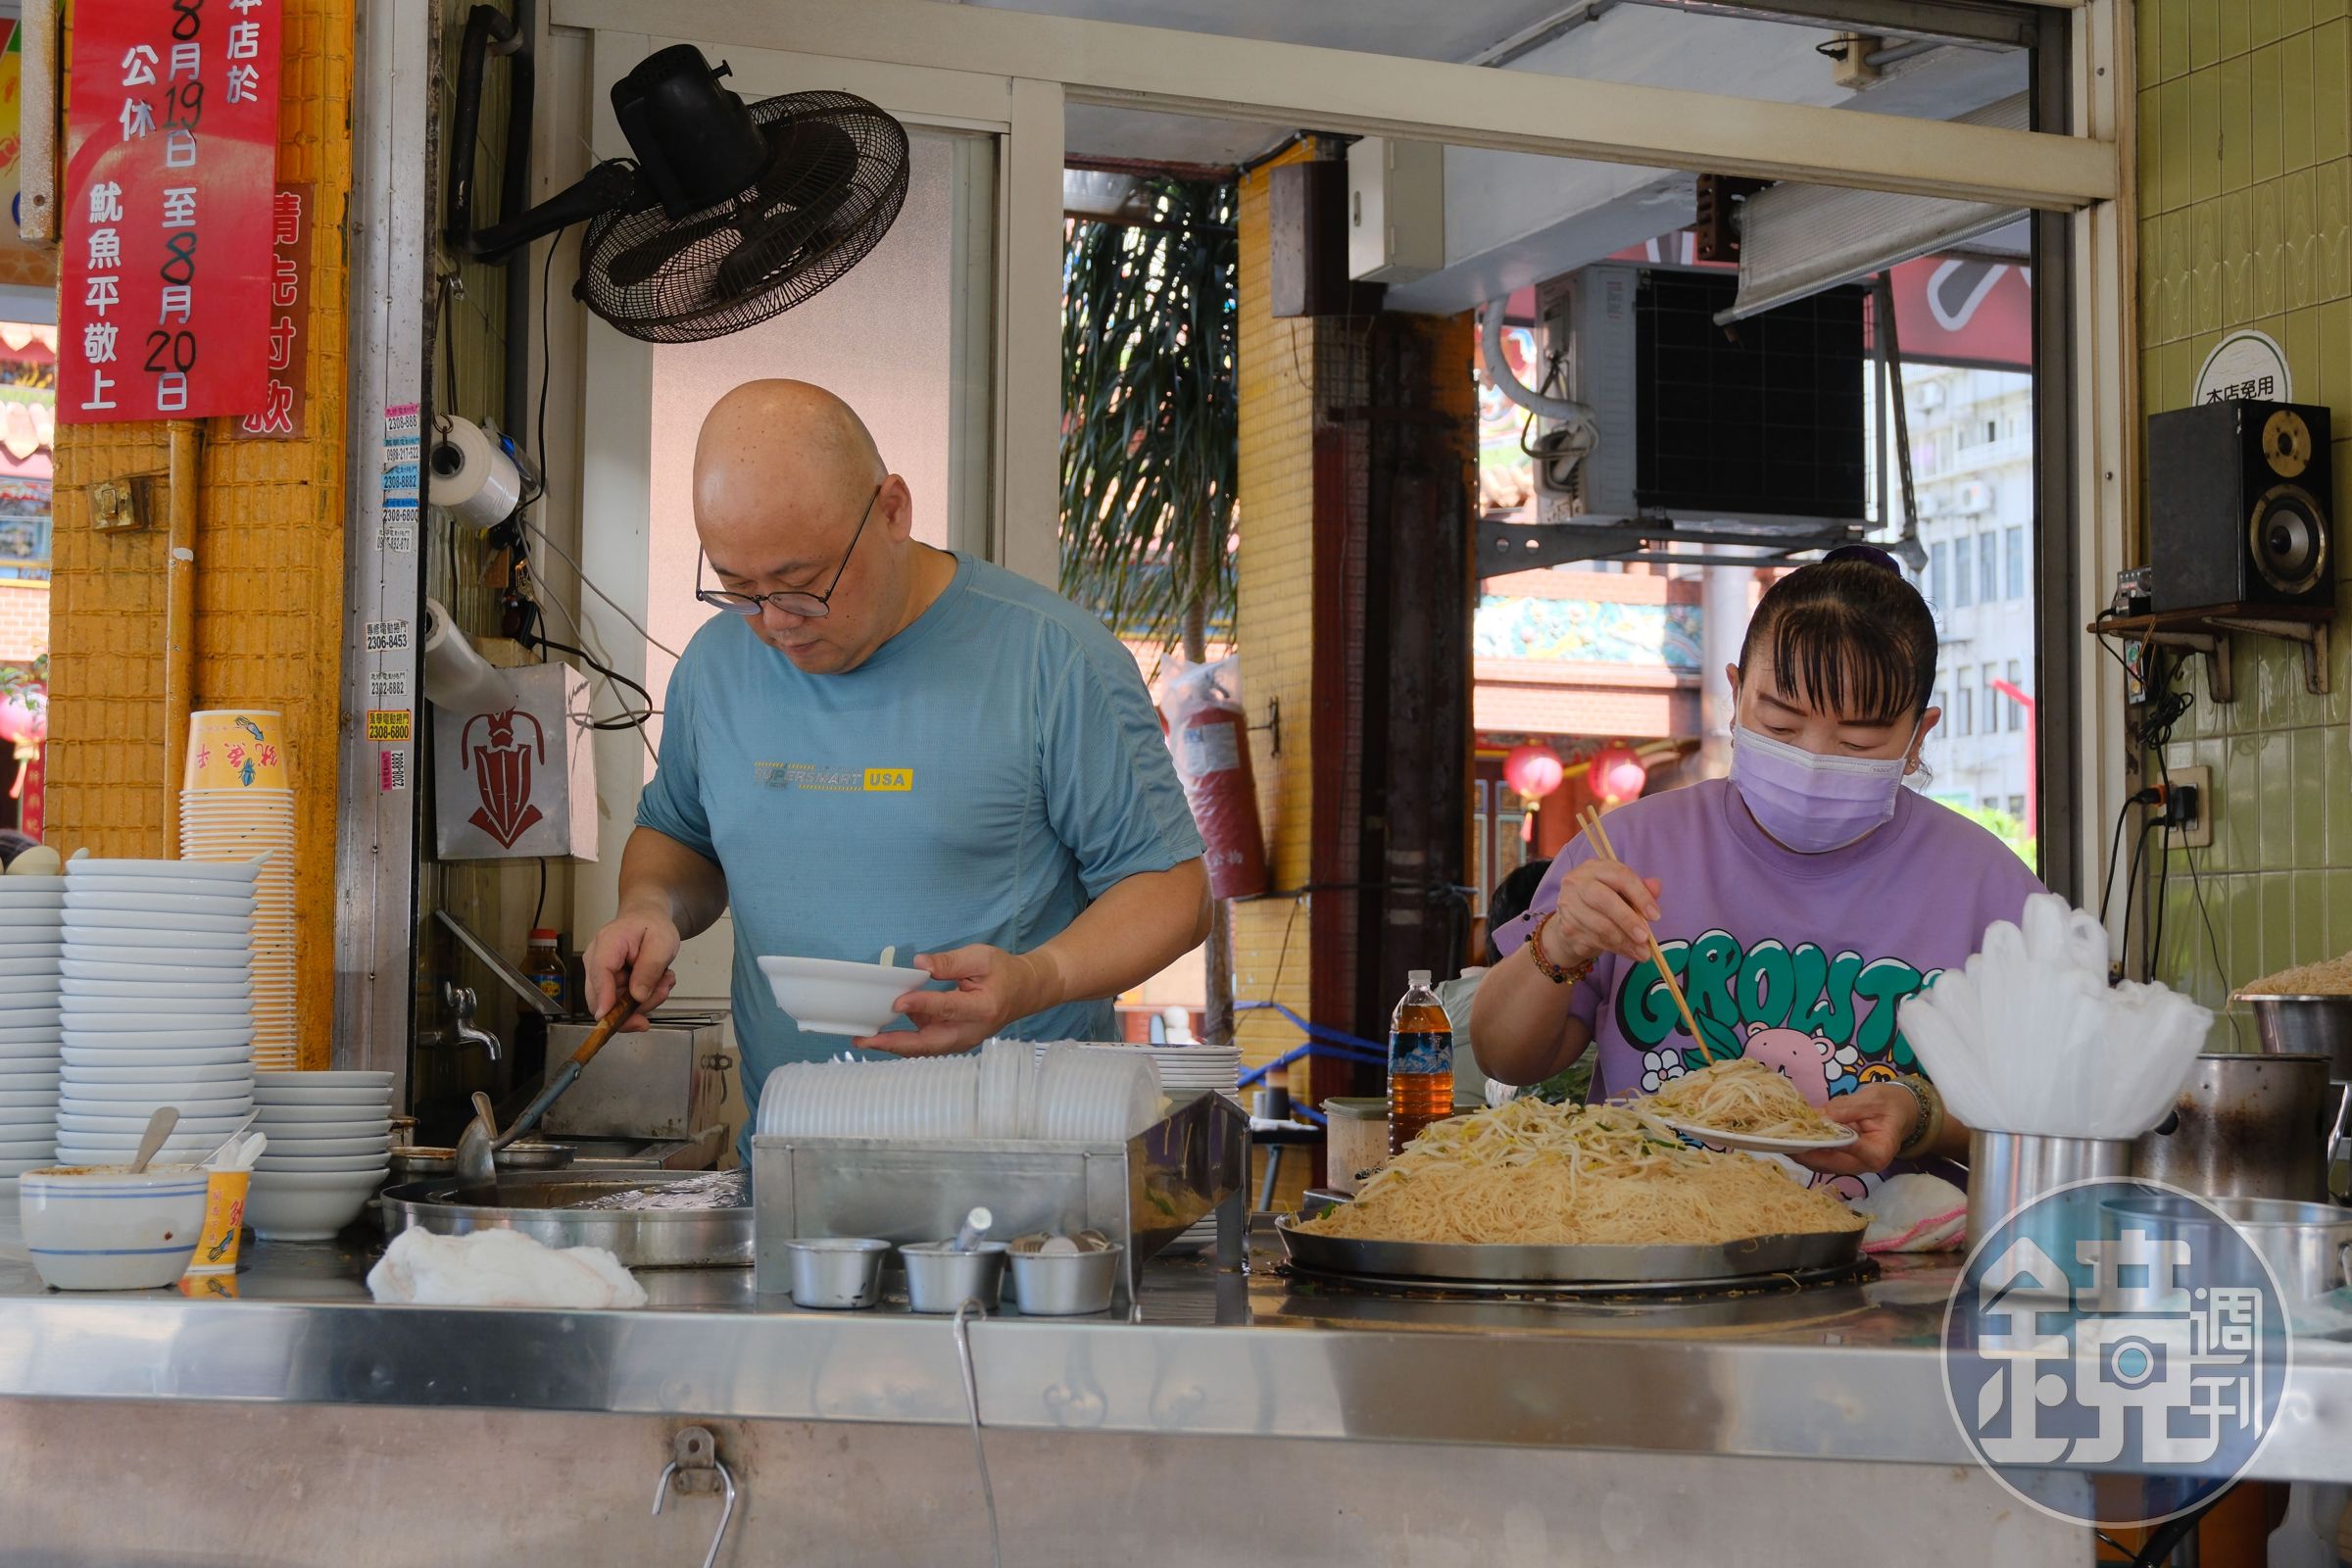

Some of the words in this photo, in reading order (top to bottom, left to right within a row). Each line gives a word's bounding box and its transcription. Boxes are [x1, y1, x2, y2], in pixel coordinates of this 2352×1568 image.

[119, 44, 160, 142] 公休
[81, 180, 123, 410] 魷魚平敬上
[368, 634, 408, 649] 2306-8453
[368, 725, 410, 739] 2308-6800
[392, 752, 404, 787] 2308-8882
[869, 773, 906, 787] USA
